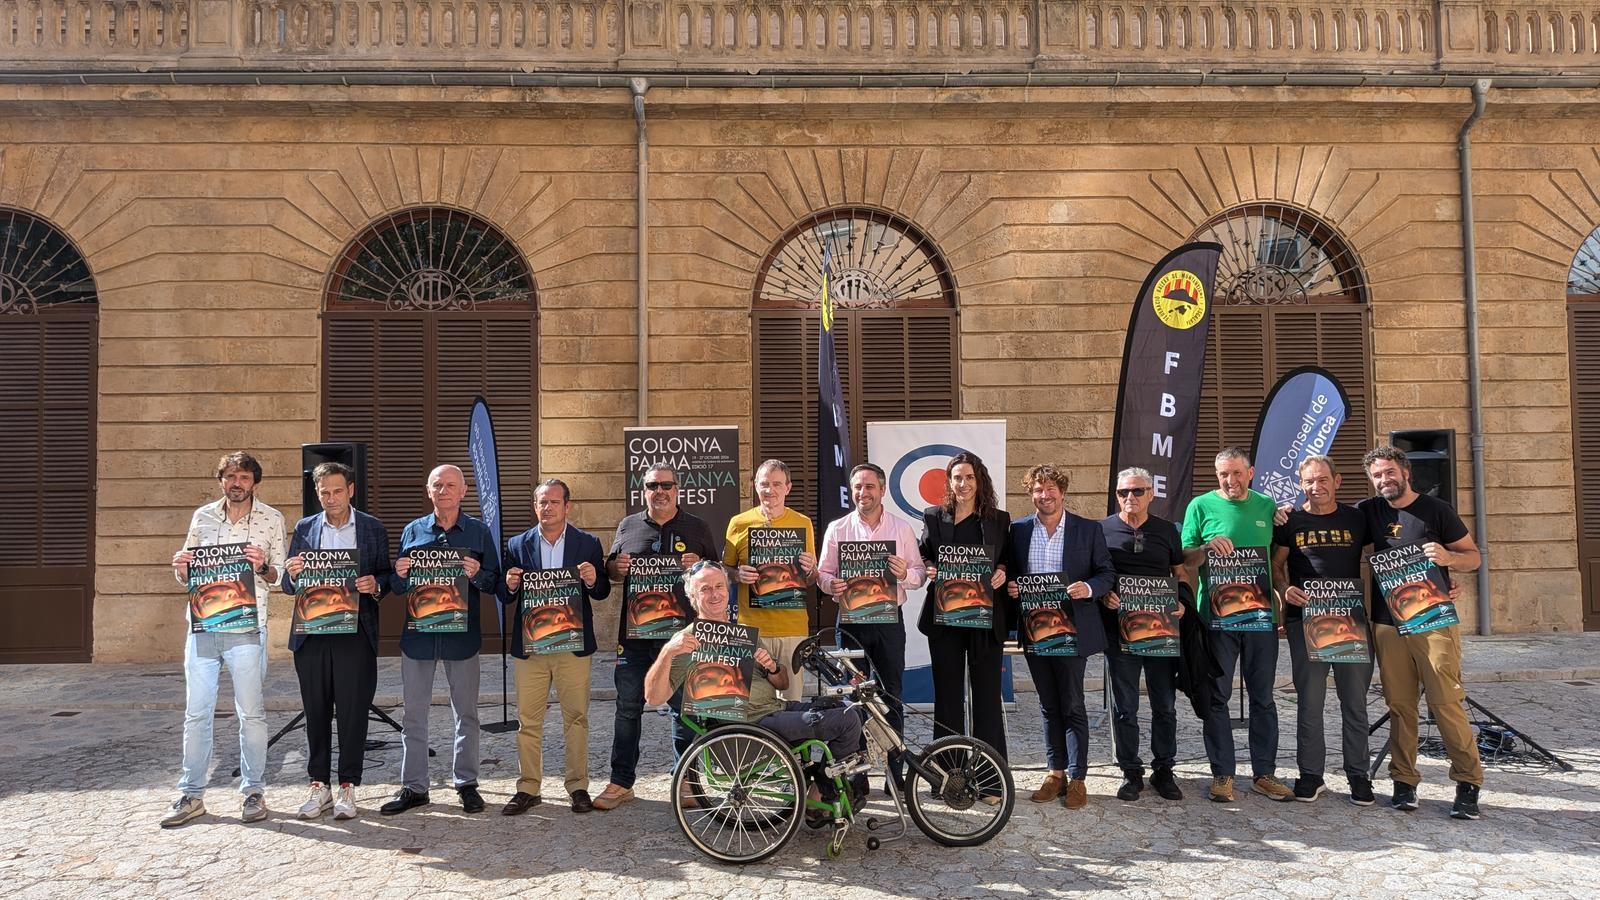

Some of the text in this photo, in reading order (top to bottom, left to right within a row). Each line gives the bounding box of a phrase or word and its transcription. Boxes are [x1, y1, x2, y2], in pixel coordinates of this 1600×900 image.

[1280, 394, 1328, 470] Consell de
[629, 437, 722, 454] COLONYA
[630, 472, 736, 488] MTANYA
[631, 489, 716, 506] FI FEST
[751, 530, 797, 539] COLONYA
[751, 539, 781, 547] PALMA
[840, 543, 888, 552] COLONYA
[410, 550, 460, 559] COLONYA
[751, 548, 803, 556] MUNTANYA
[938, 545, 985, 556] COLONYA
[1208, 550, 1258, 559] CONYA
[1370, 544, 1420, 565] COLONYA
[299, 552, 350, 560] COLONYA
[751, 556, 795, 564] FILM FEST
[841, 552, 872, 560] PALMA
[938, 555, 969, 564] PALMA
[190, 557, 225, 567] PALMA
[302, 561, 333, 569] ALMA
[410, 559, 442, 568] PALMA
[630, 558, 677, 566] COLONYA
[841, 561, 889, 569] MUNTANY
[1208, 559, 1241, 567] PALMA
[1374, 559, 1408, 573] PALMA
[190, 562, 251, 576] MUNTANYA
[938, 563, 992, 574] MUNTANYA
[1210, 567, 1267, 576] MUNTANYA
[1378, 561, 1436, 581] MUNTANYA
[299, 569, 357, 578] MUNTANYA
[523, 570, 572, 581] COLONYA
[841, 569, 885, 578] FILM FEST
[938, 571, 982, 582] FILM FEST
[191, 572, 240, 585] FILM FEST
[298, 578, 346, 587] FILM FEST
[410, 576, 456, 585] FILM FEST
[630, 575, 684, 584] MUNTANYA
[1017, 575, 1060, 585] COLONYA
[1119, 577, 1168, 588] COLONYA
[1210, 576, 1257, 585] FILM FEST
[1381, 571, 1429, 590] FILM FEST
[523, 580, 555, 590] PALMA
[630, 584, 673, 592] FILM FEST
[1018, 584, 1047, 593] PALMA
[1304, 581, 1355, 590] COLONYA
[524, 587, 580, 599] MUNTANYA
[1120, 586, 1151, 596] PALMA
[1304, 590, 1338, 598] PALMA
[1020, 591, 1070, 601] MUNTANYA
[1120, 594, 1176, 605] MUNTANYA
[524, 596, 570, 608] FILM FEST
[1021, 601, 1061, 610] FILM FEST
[1305, 599, 1363, 607] MUNTANYA
[1120, 602, 1166, 613] FILM FEST
[1305, 608, 1352, 616] FILM FEST
[696, 621, 748, 638] COLONYA
[695, 631, 729, 645] PALMA
[691, 652, 741, 668] FILM FEST
